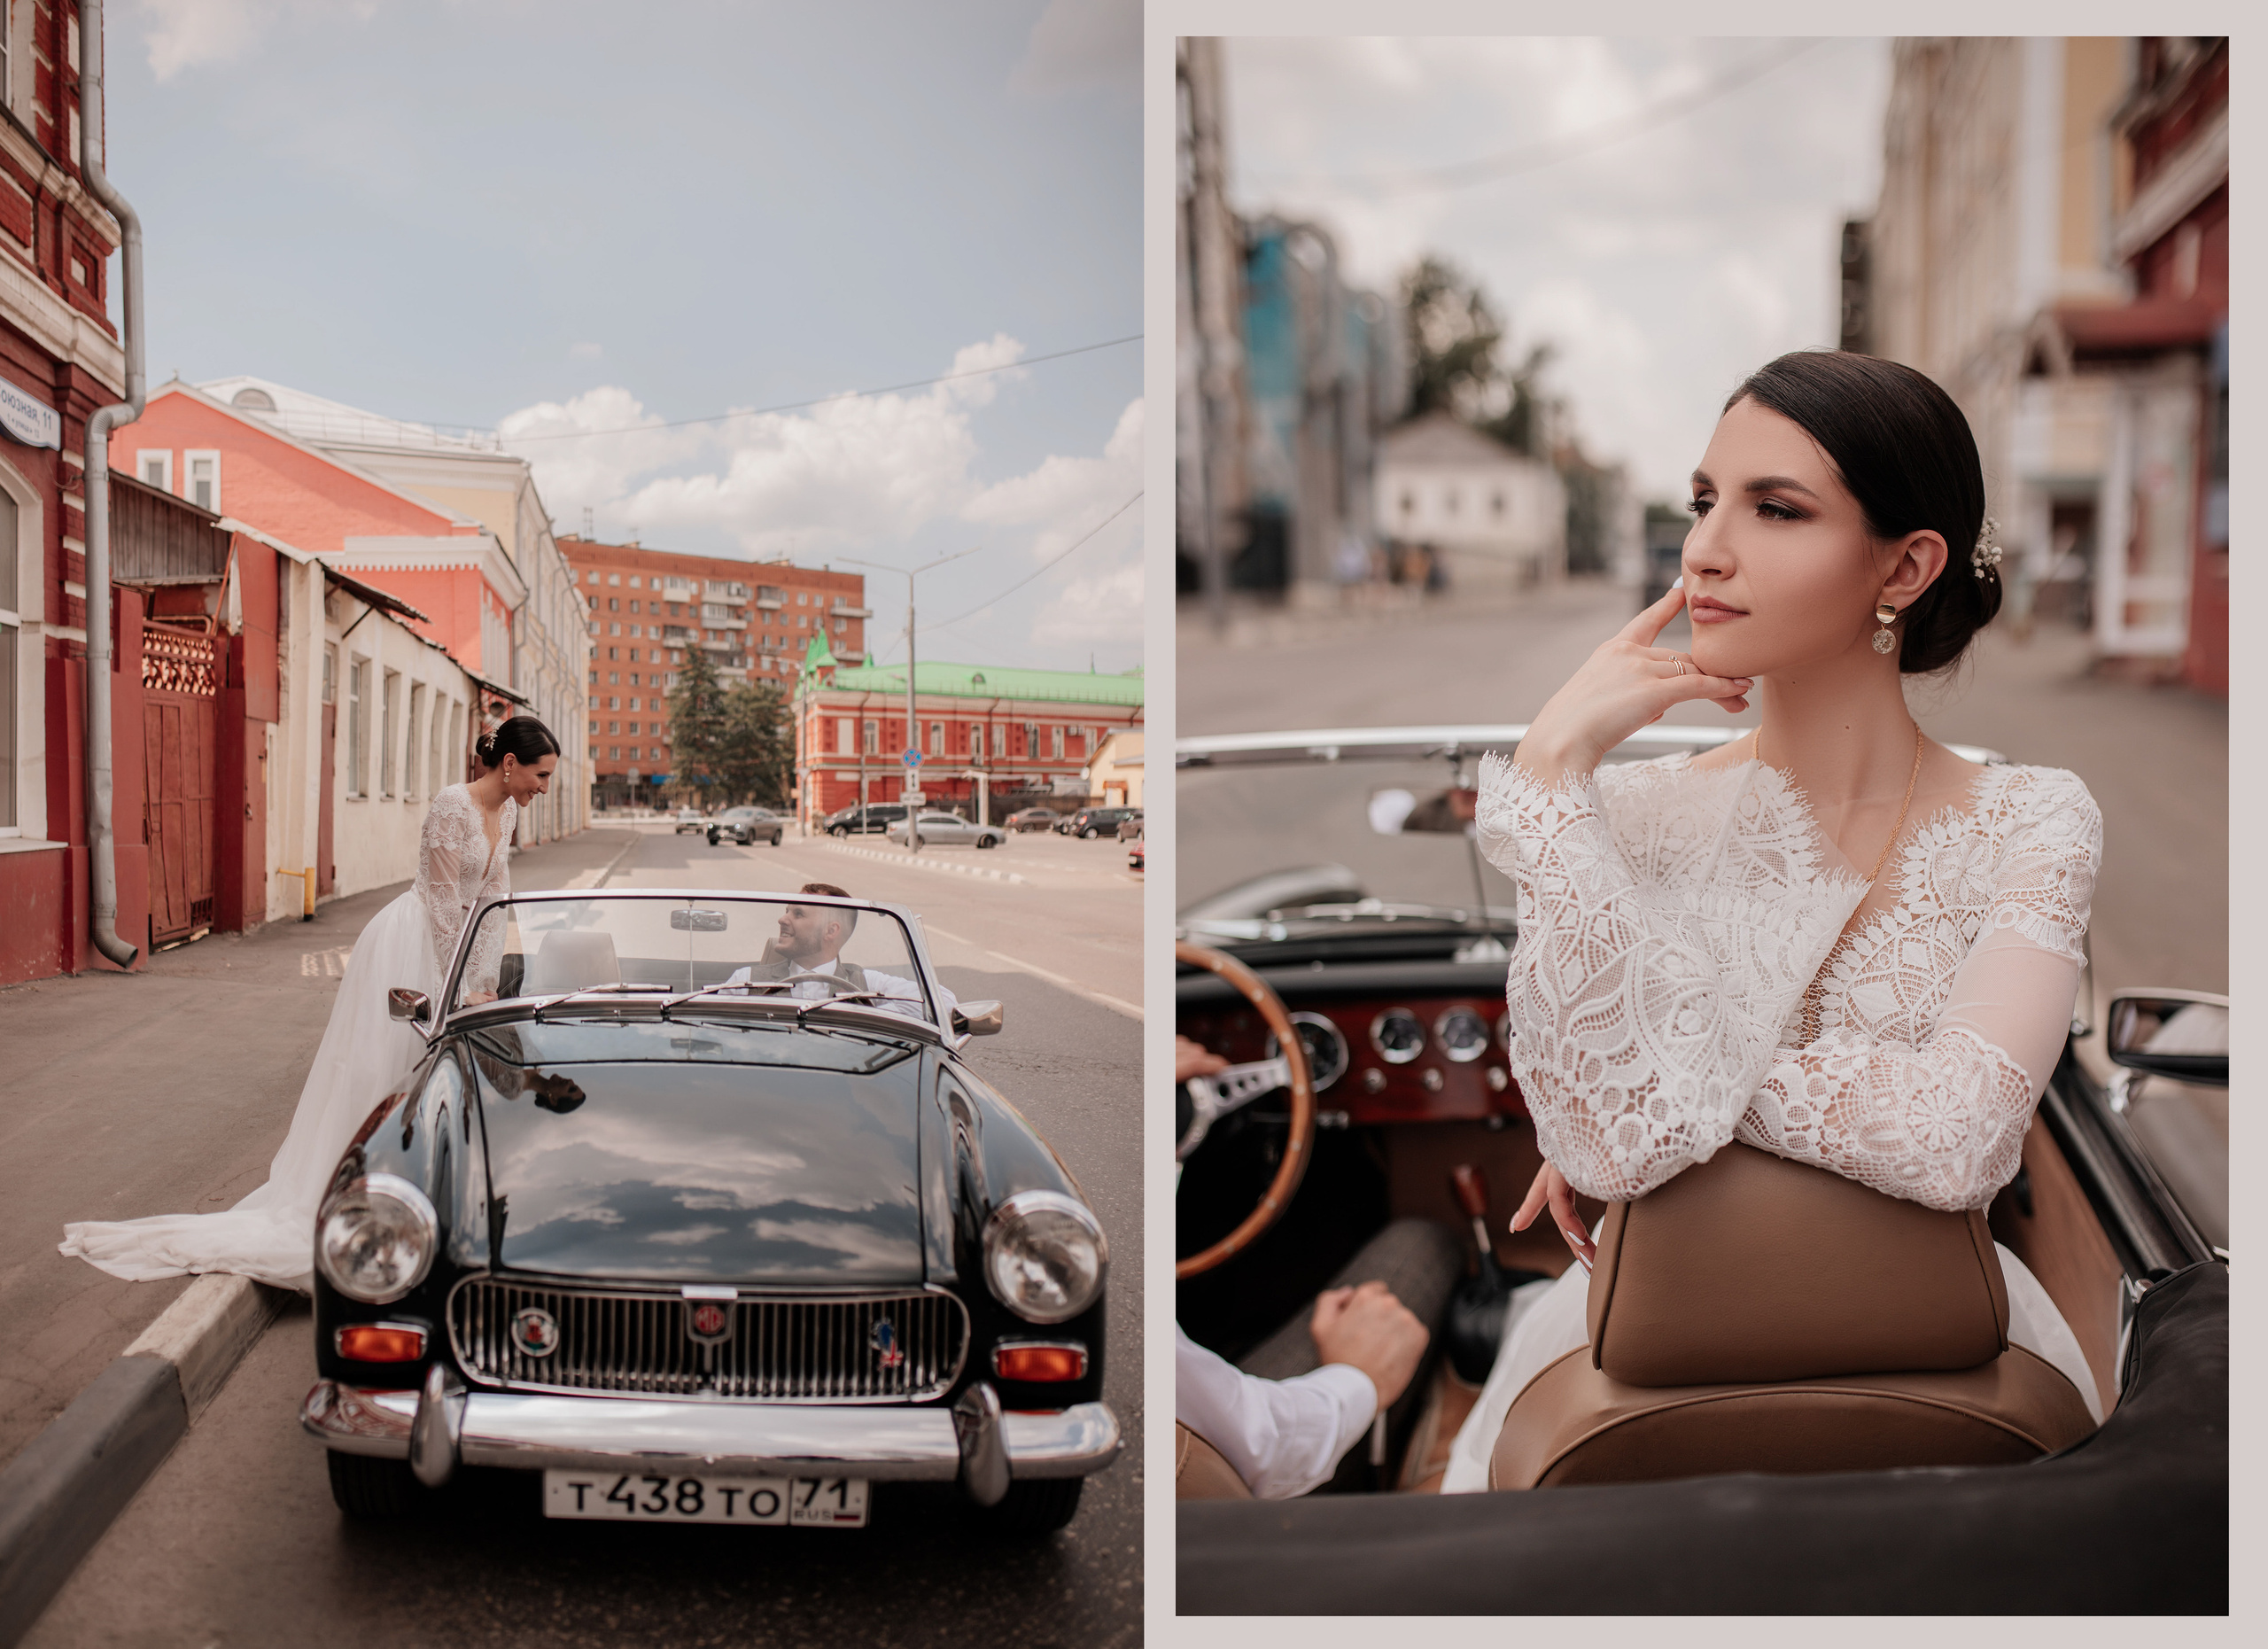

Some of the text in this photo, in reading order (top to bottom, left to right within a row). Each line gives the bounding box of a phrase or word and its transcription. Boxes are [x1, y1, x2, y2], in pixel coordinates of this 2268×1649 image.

[0, 390, 51, 431] оюзная, 11
[697, 1309, 722, 1332] MG
[799, 1478, 847, 1509] 71
[795, 1510, 832, 1521] RUS
